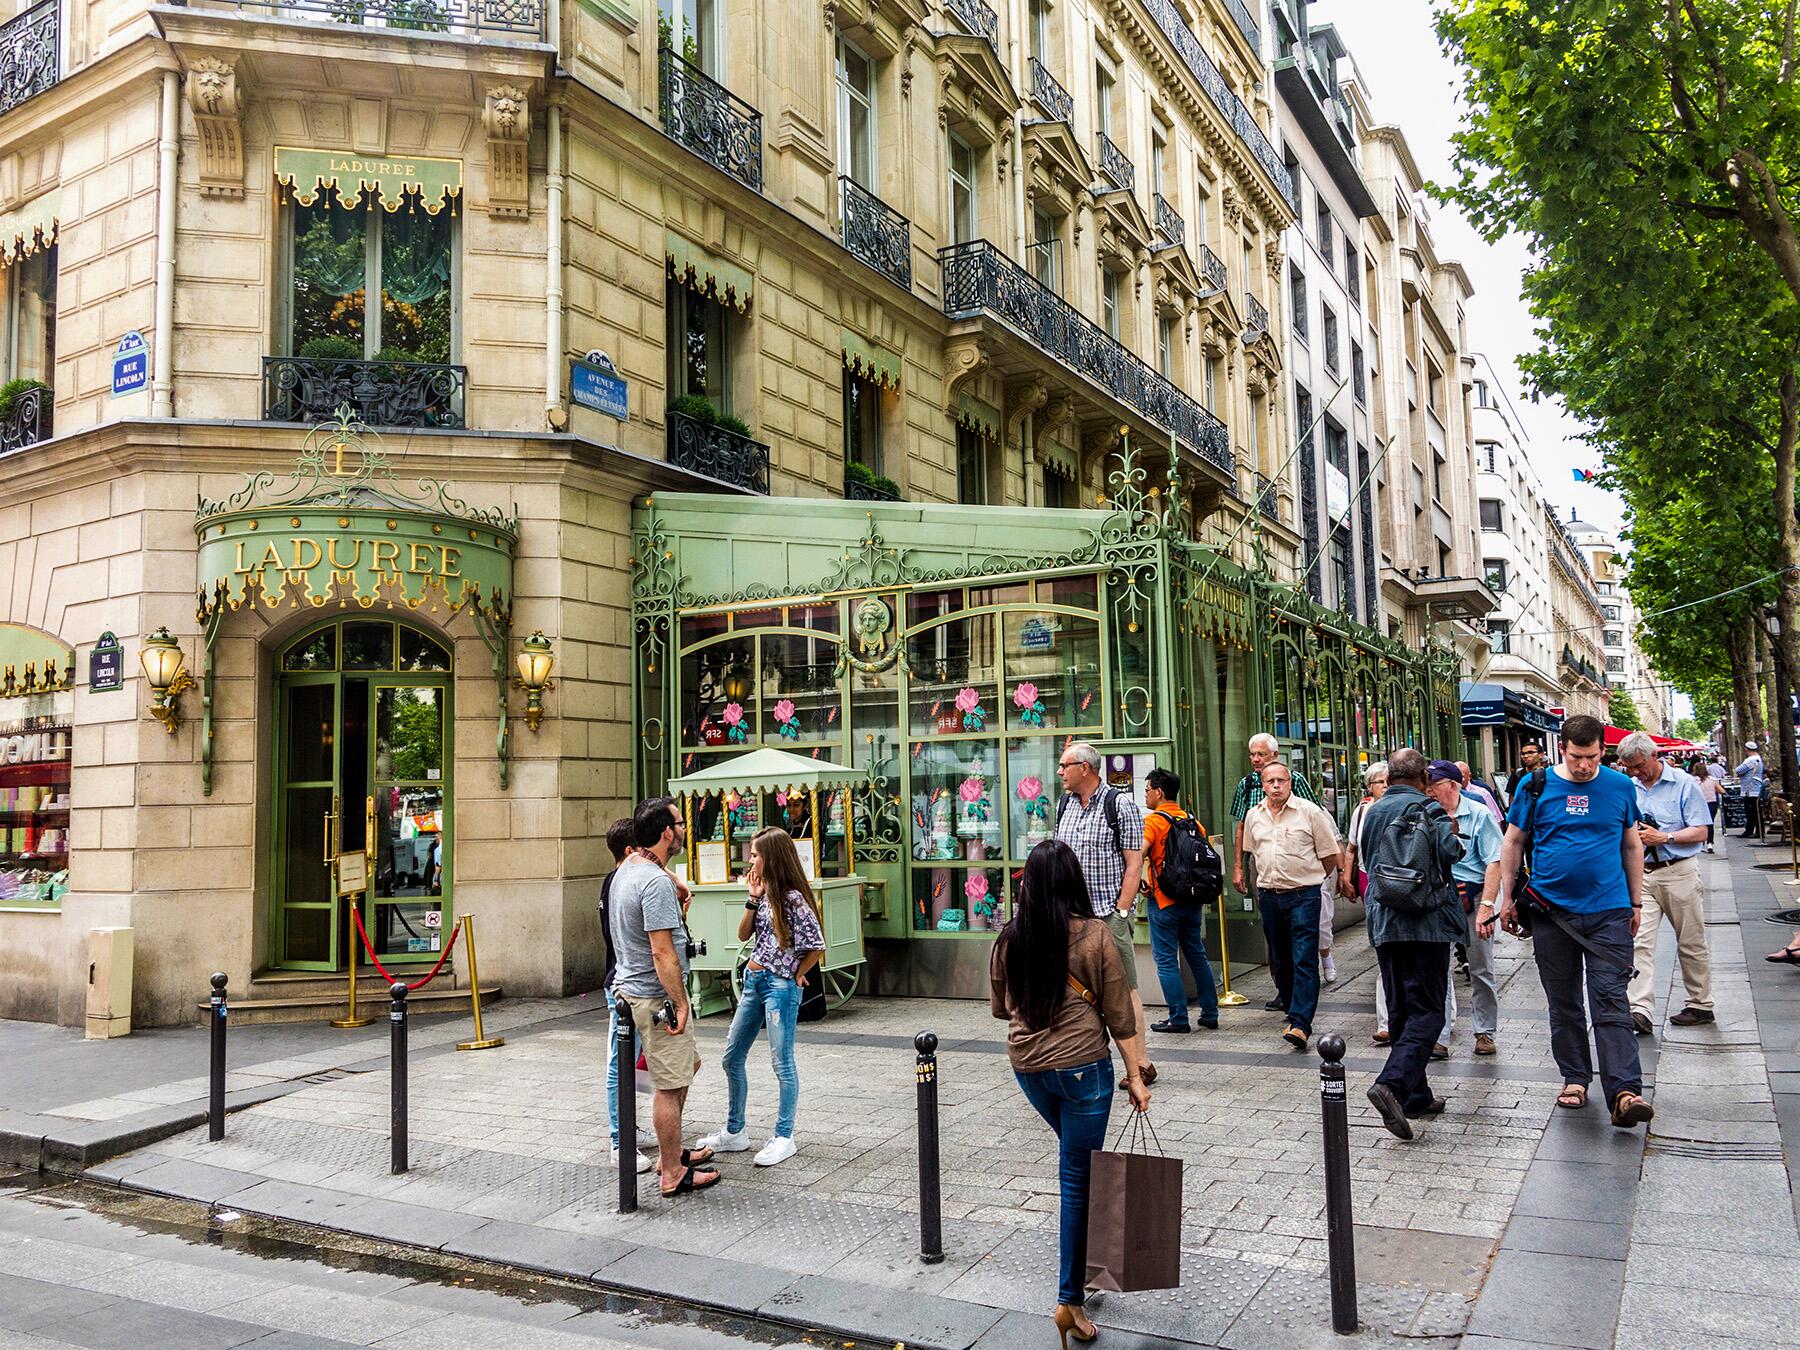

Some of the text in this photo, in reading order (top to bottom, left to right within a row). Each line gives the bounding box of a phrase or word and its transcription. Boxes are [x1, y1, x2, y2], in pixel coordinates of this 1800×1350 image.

[330, 159, 416, 176] LADUREE
[123, 361, 138, 374] RUE
[115, 371, 144, 388] LINCOLN
[587, 373, 615, 390] AVENUE
[594, 386, 608, 397] DES
[233, 537, 463, 578] LADUREE
[101, 654, 111, 664] RUE
[97, 667, 115, 678] LINCOLN
[1566, 806, 1589, 814] BEAR
